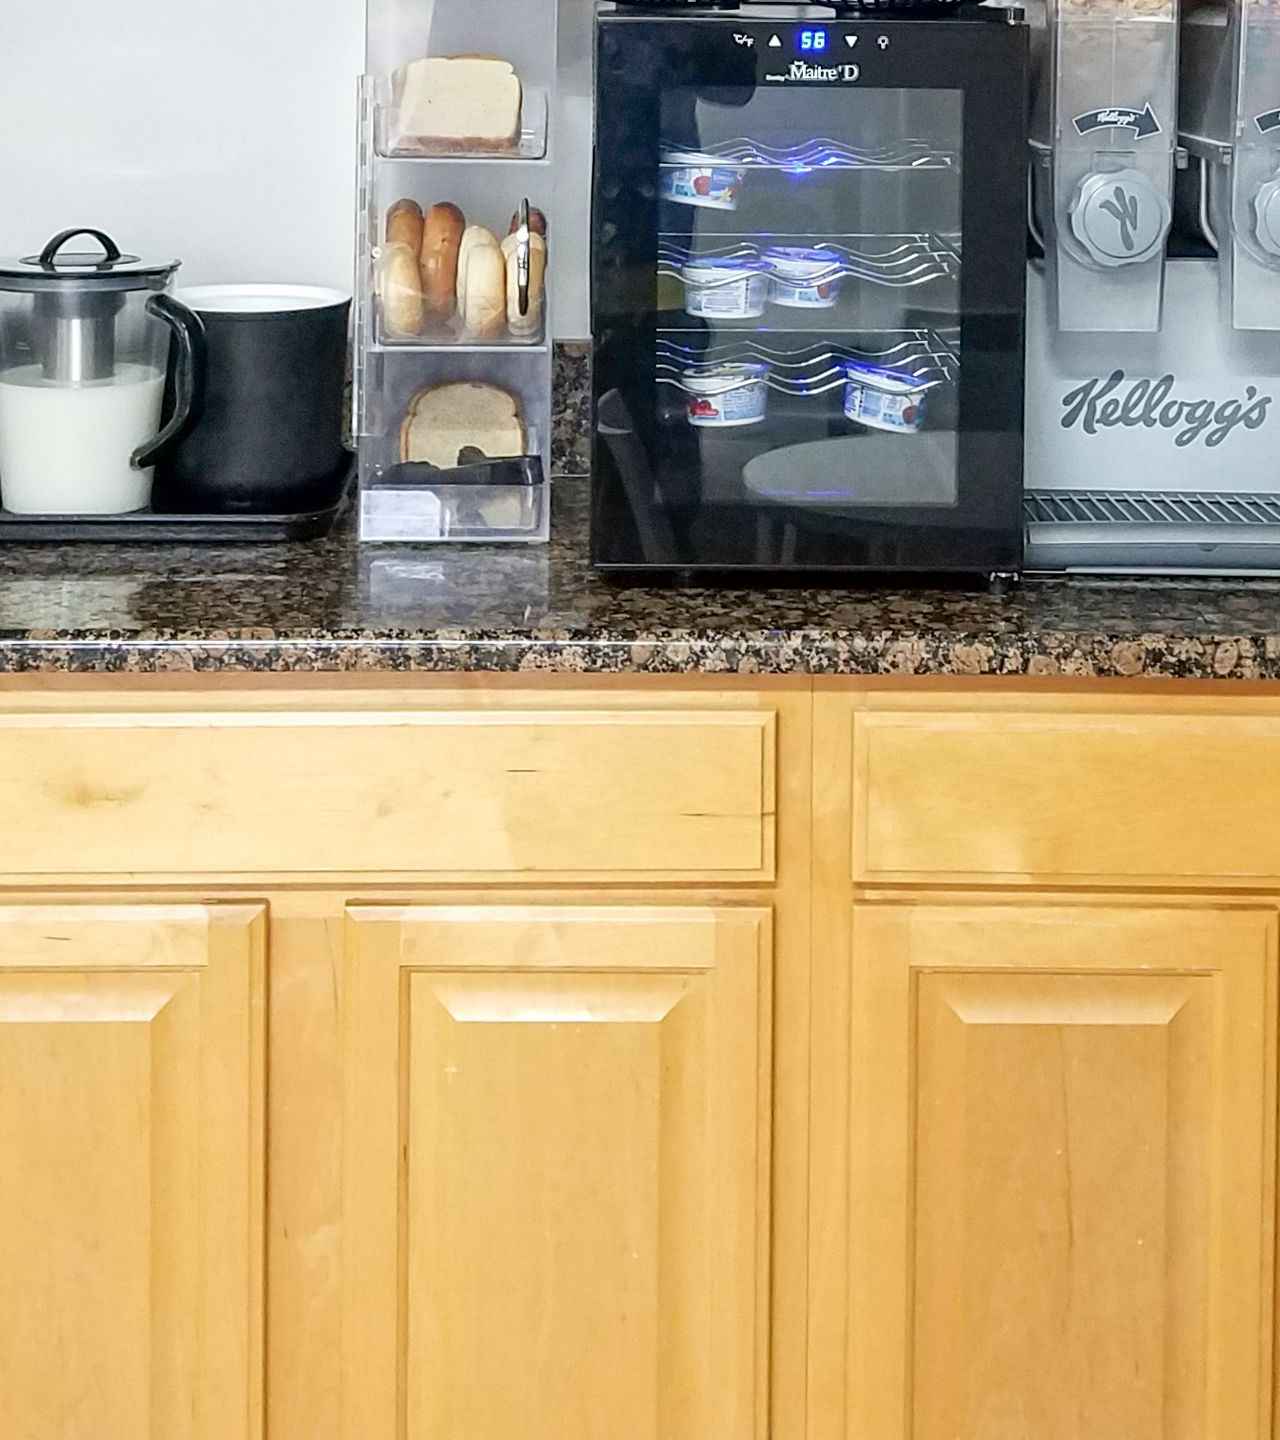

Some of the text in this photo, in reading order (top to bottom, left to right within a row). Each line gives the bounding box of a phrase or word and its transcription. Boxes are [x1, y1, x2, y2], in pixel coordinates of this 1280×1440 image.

[801, 31, 825, 49] 56
[1096, 110, 1136, 125] Kellogg's
[1061, 368, 1272, 448] Kellogg's
